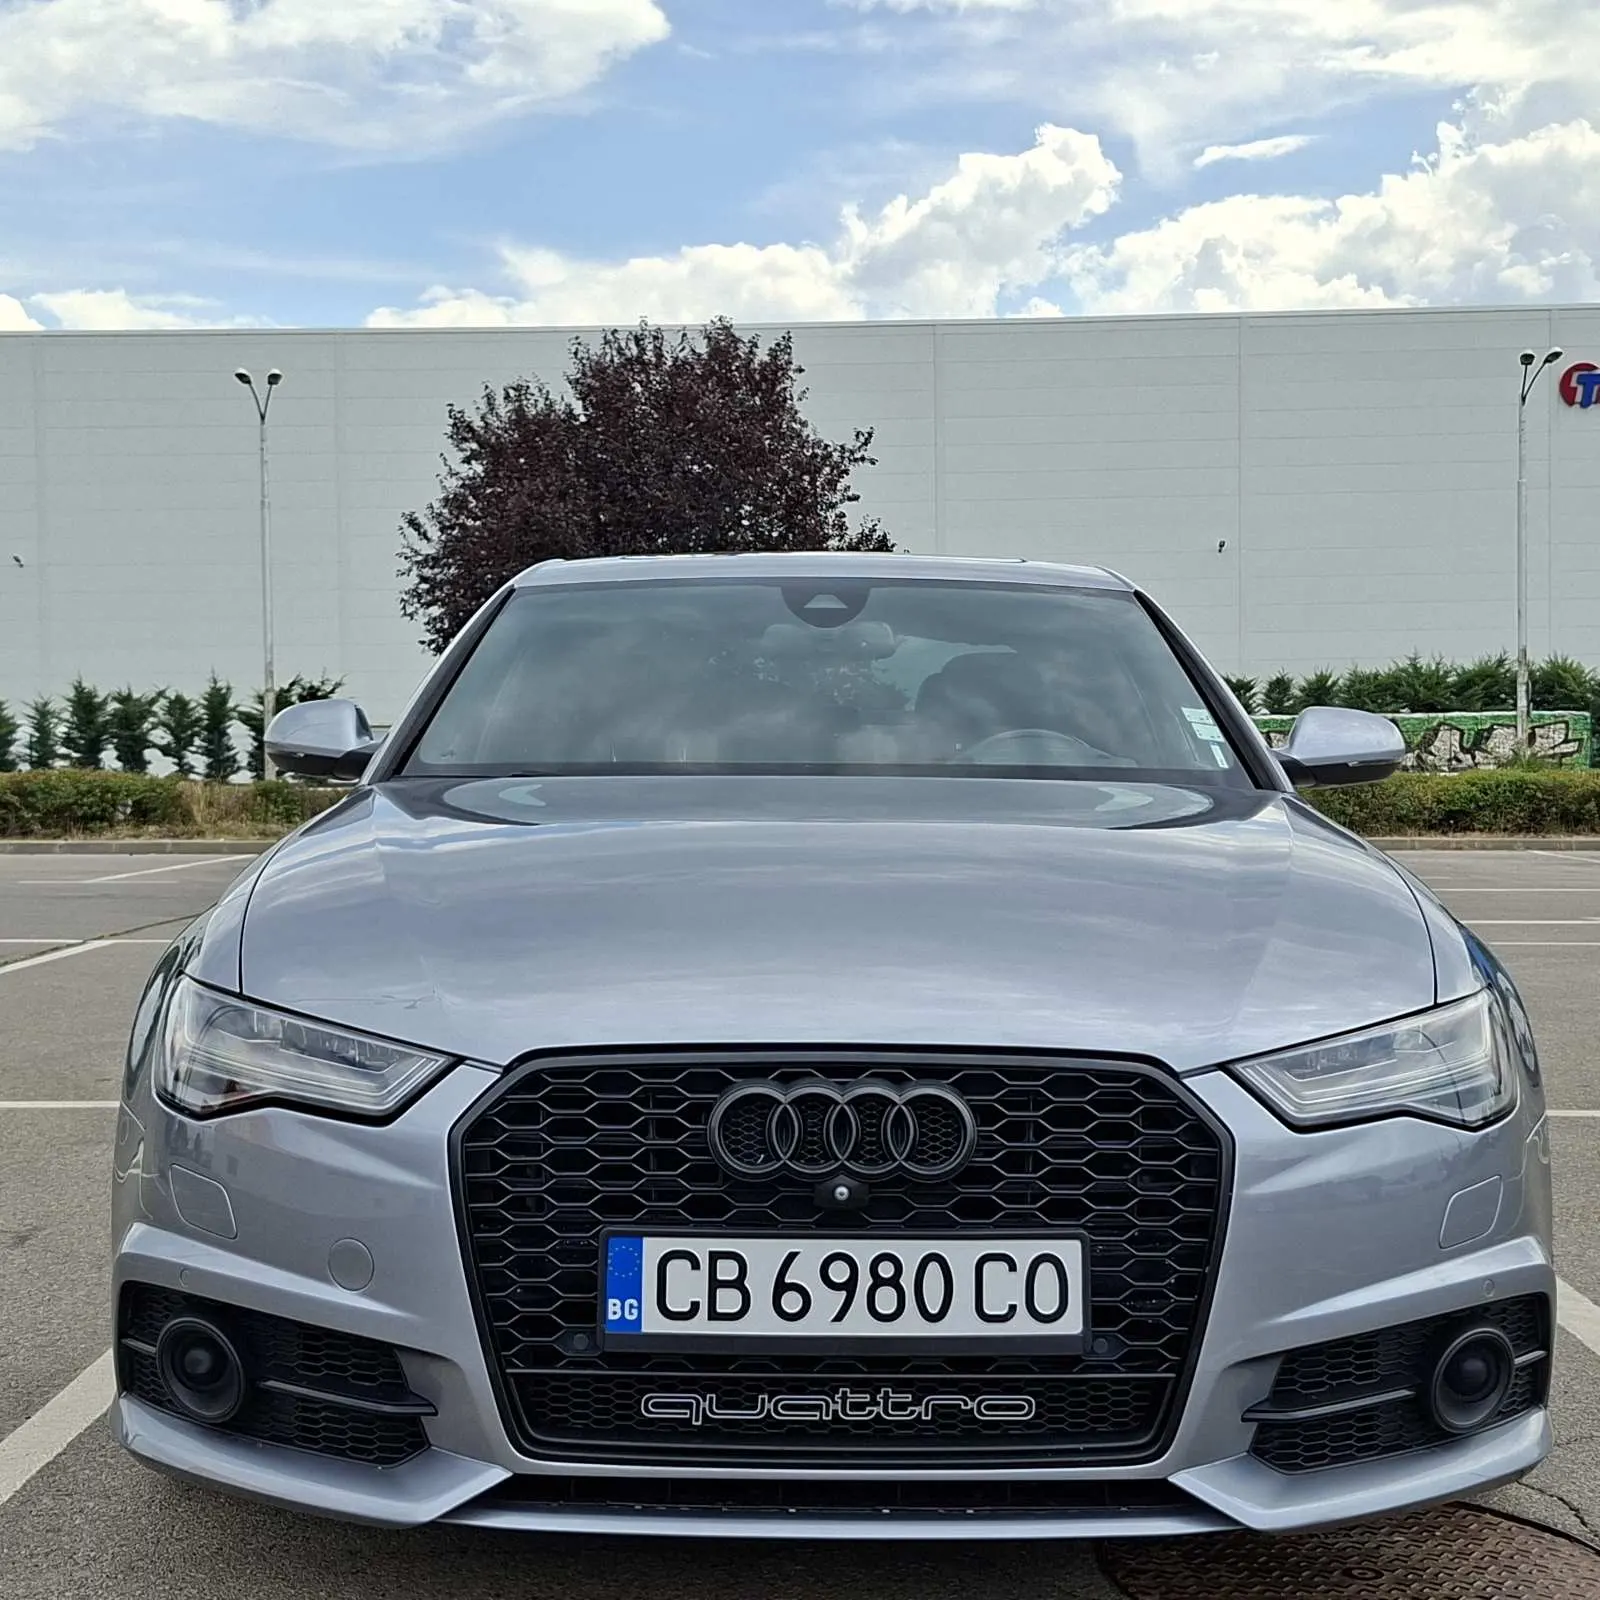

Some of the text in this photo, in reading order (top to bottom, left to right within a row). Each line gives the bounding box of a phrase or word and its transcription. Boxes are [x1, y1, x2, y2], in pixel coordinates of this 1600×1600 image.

[655, 1249, 1070, 1324] CB 6980 CO
[607, 1298, 640, 1321] BG
[641, 1388, 1036, 1425] quattro
